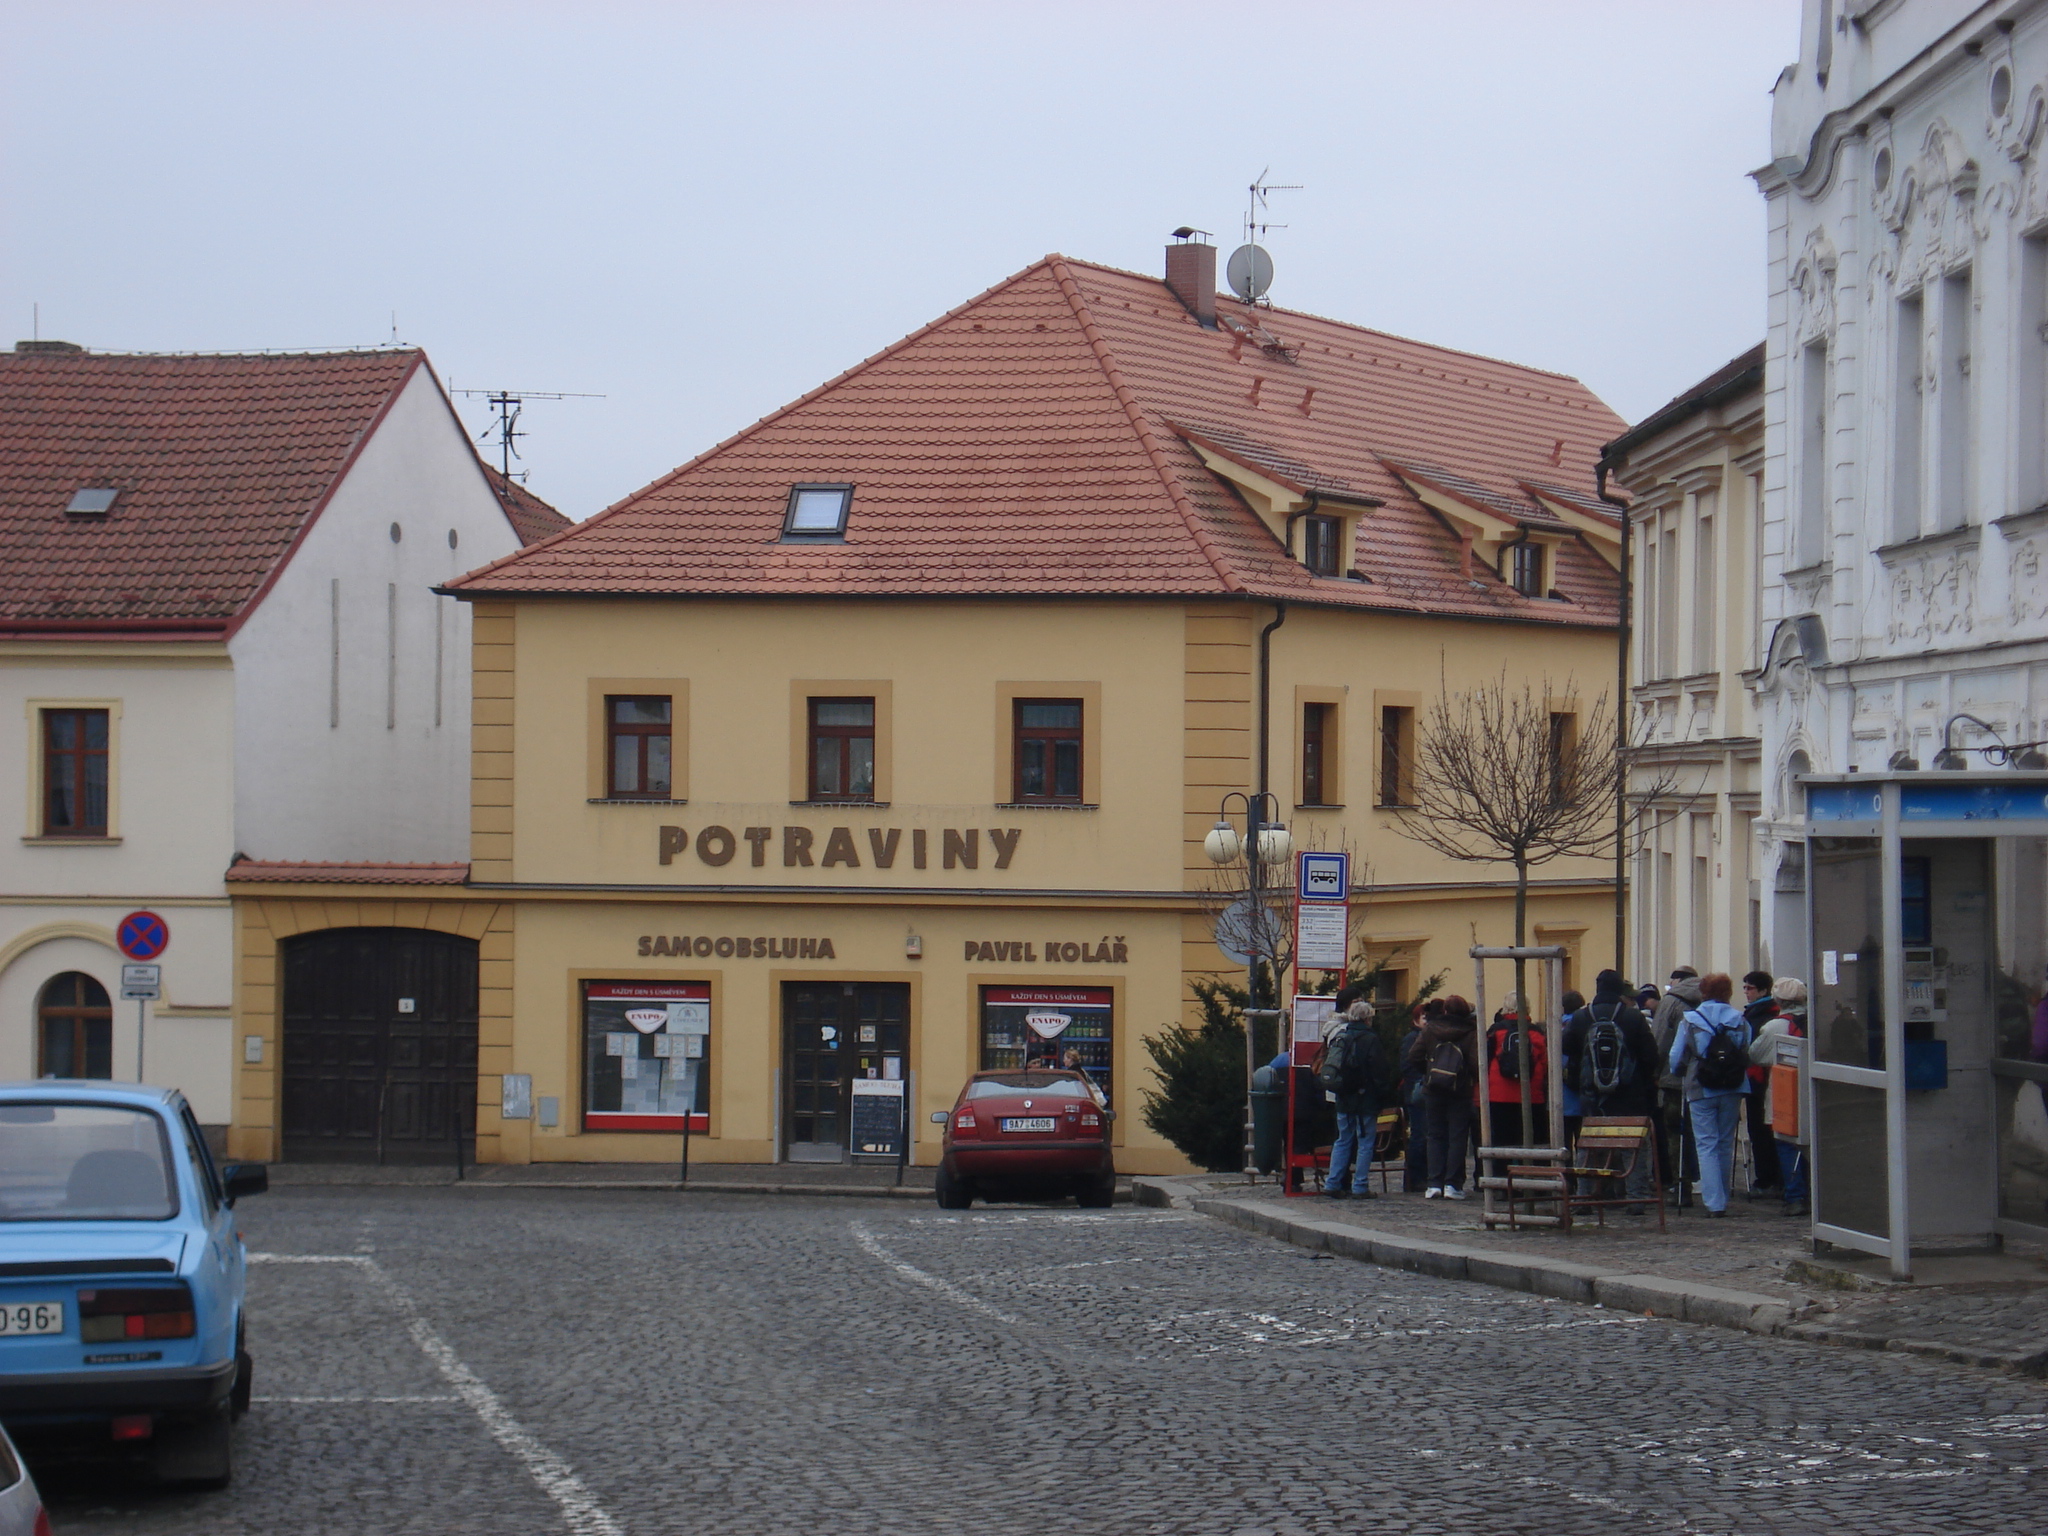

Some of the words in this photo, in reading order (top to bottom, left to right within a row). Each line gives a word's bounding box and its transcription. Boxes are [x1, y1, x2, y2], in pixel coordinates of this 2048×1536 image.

[659, 825, 1022, 869] POTRAVINY
[638, 936, 836, 959] SAMOOBSLUHA
[965, 941, 1037, 962] PAVEL
[1045, 936, 1129, 963] KOLÁŘ
[611, 987, 633, 995] KAŽDÝ
[1011, 992, 1033, 1000] KAŽDÝ
[1008, 1119, 1024, 1129] 9A7
[1030, 1119, 1051, 1128] 4606
